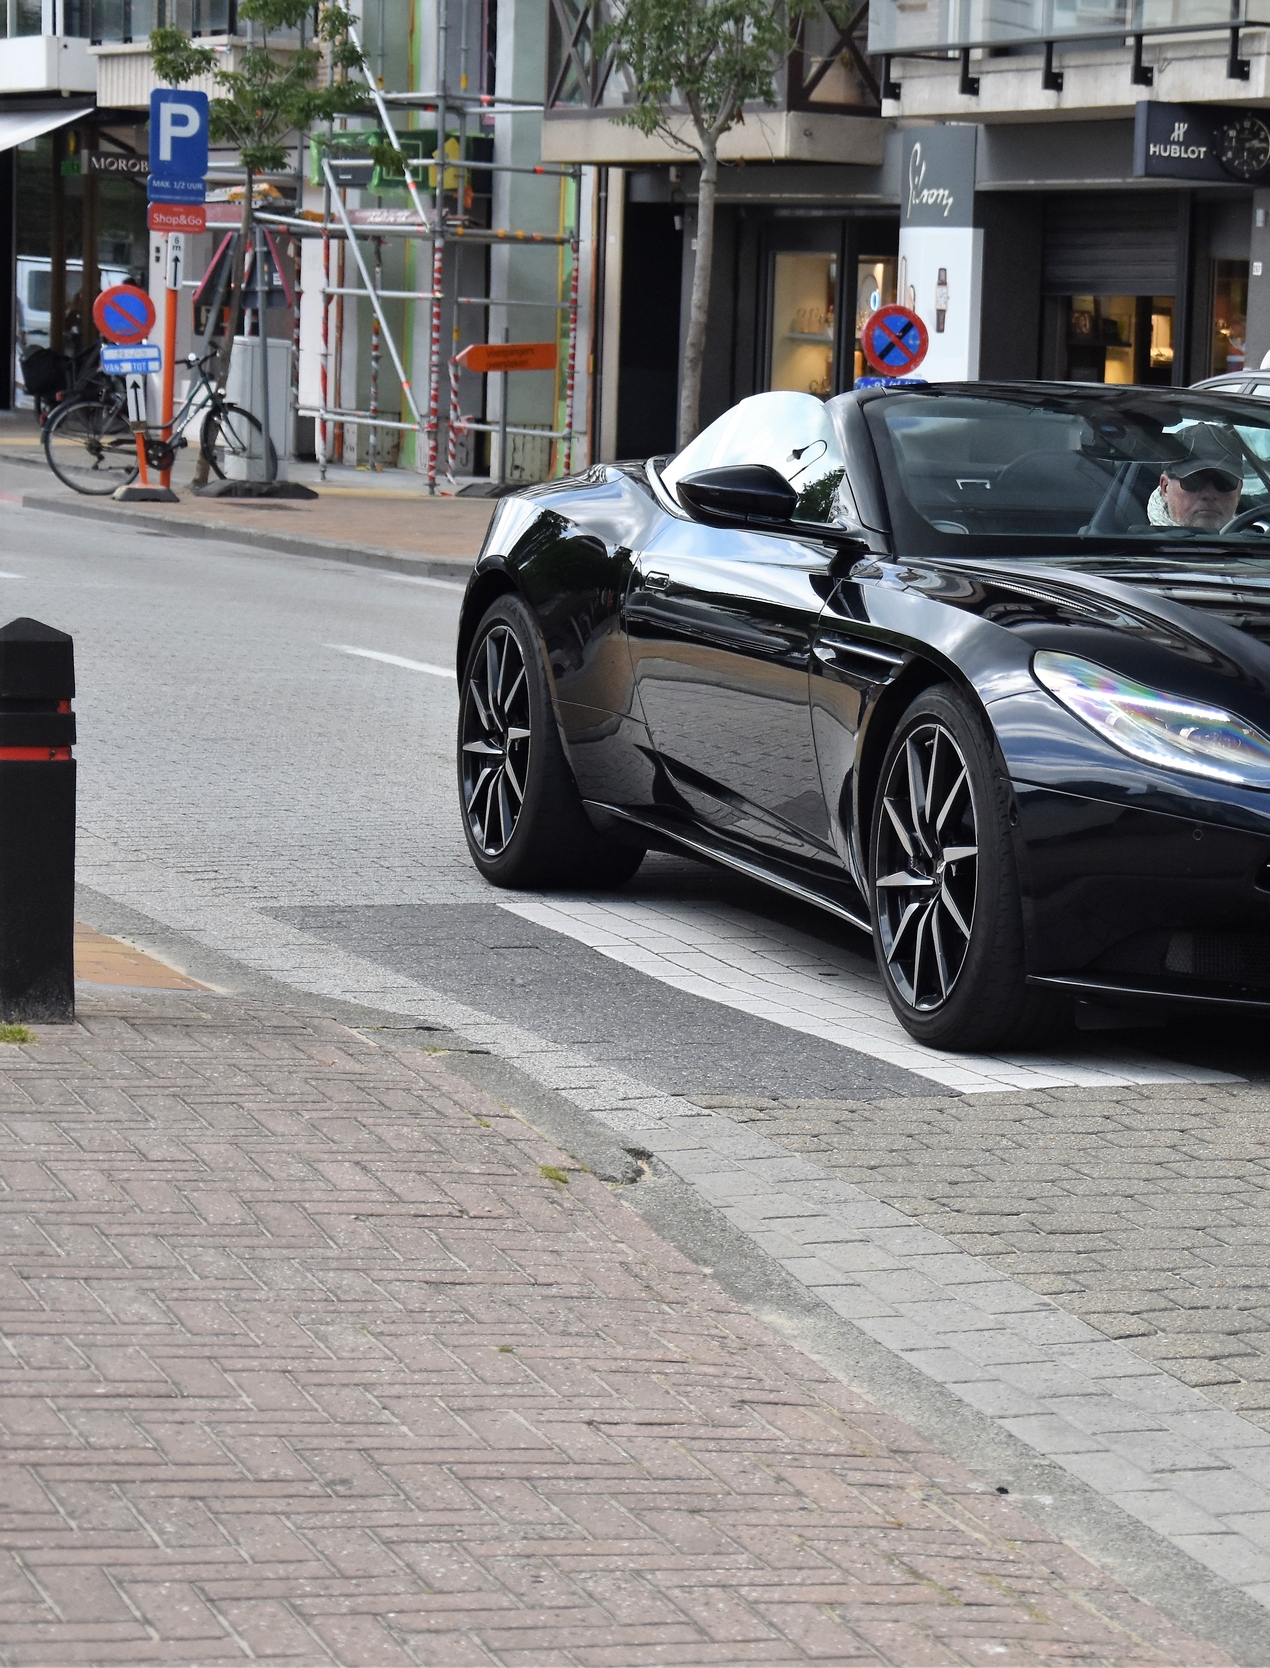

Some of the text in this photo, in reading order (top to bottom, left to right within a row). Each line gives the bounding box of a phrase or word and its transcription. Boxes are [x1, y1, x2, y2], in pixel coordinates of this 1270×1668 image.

[159, 102, 200, 161] P
[1149, 143, 1207, 159] HUBLOT
[186, 182, 203, 190] UUR
[153, 213, 202, 226] Shop&Go
